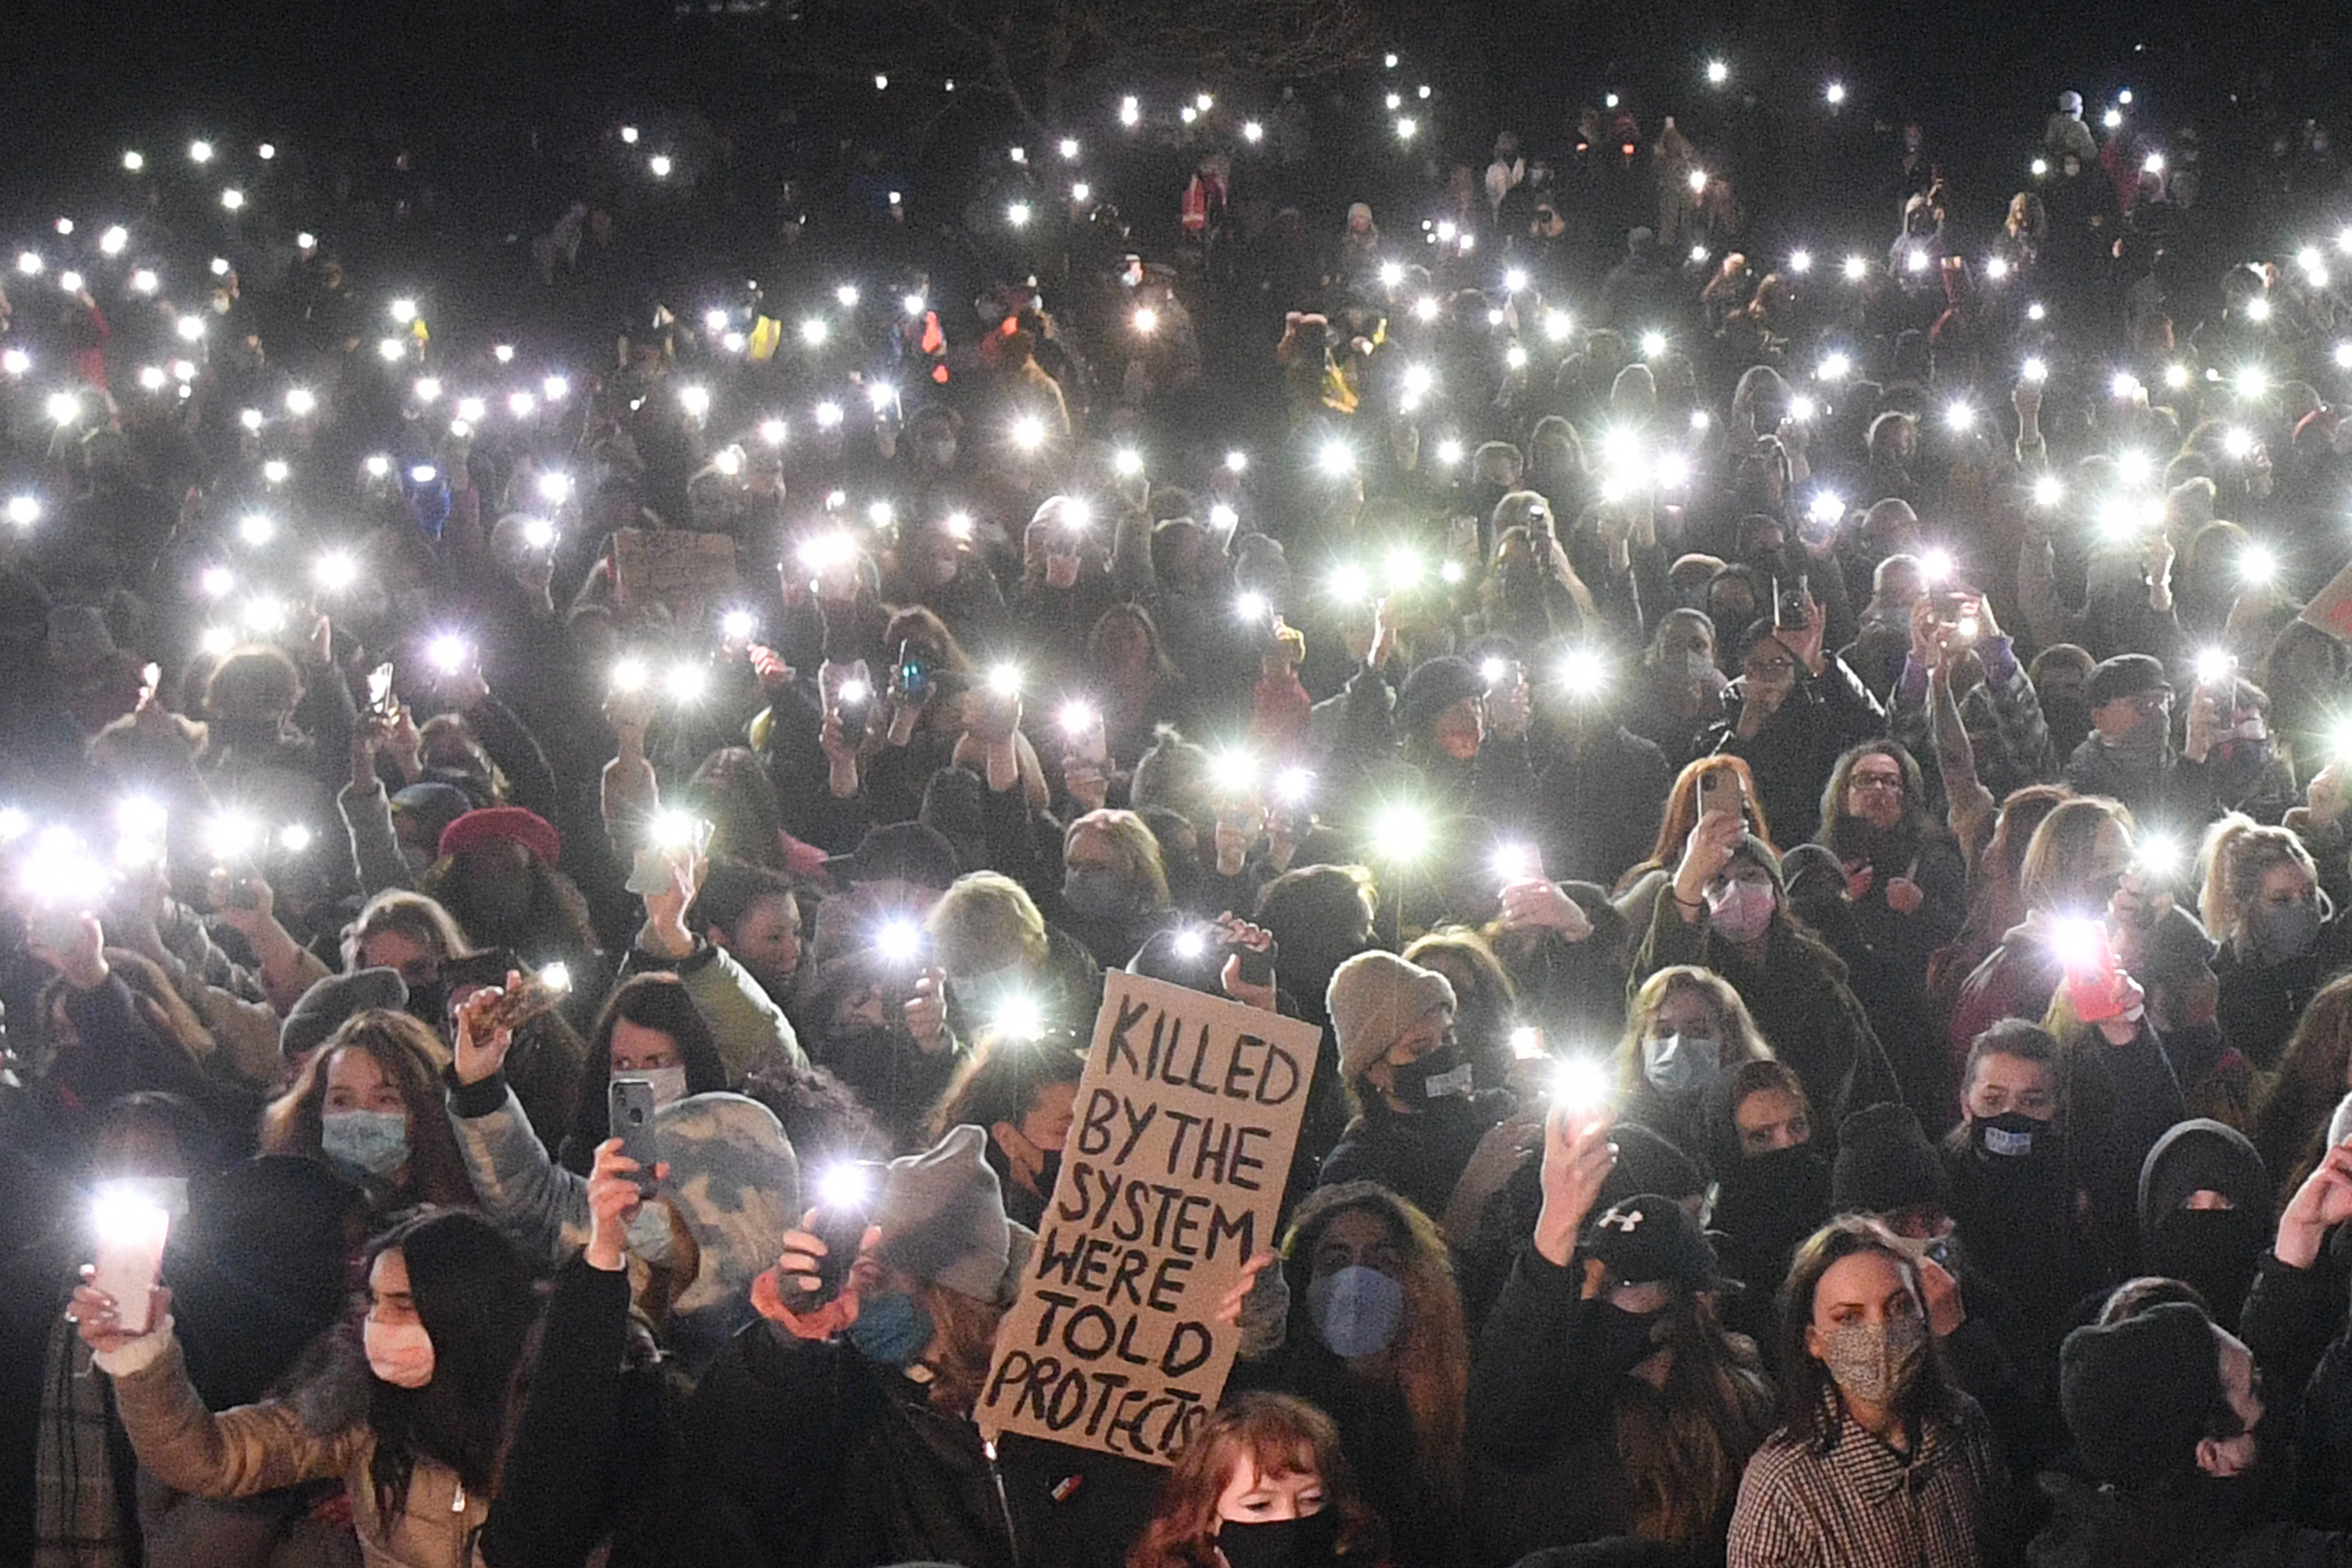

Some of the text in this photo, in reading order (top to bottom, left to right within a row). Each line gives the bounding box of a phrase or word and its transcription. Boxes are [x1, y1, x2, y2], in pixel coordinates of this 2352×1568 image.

[1107, 994, 1300, 1106] KILLED
[1078, 1088, 1271, 1190] BY THE
[1058, 1162, 1254, 1267] SYSTEM
[1036, 1228, 1194, 1311] WE'RE
[1035, 1290, 1213, 1377] TOLD
